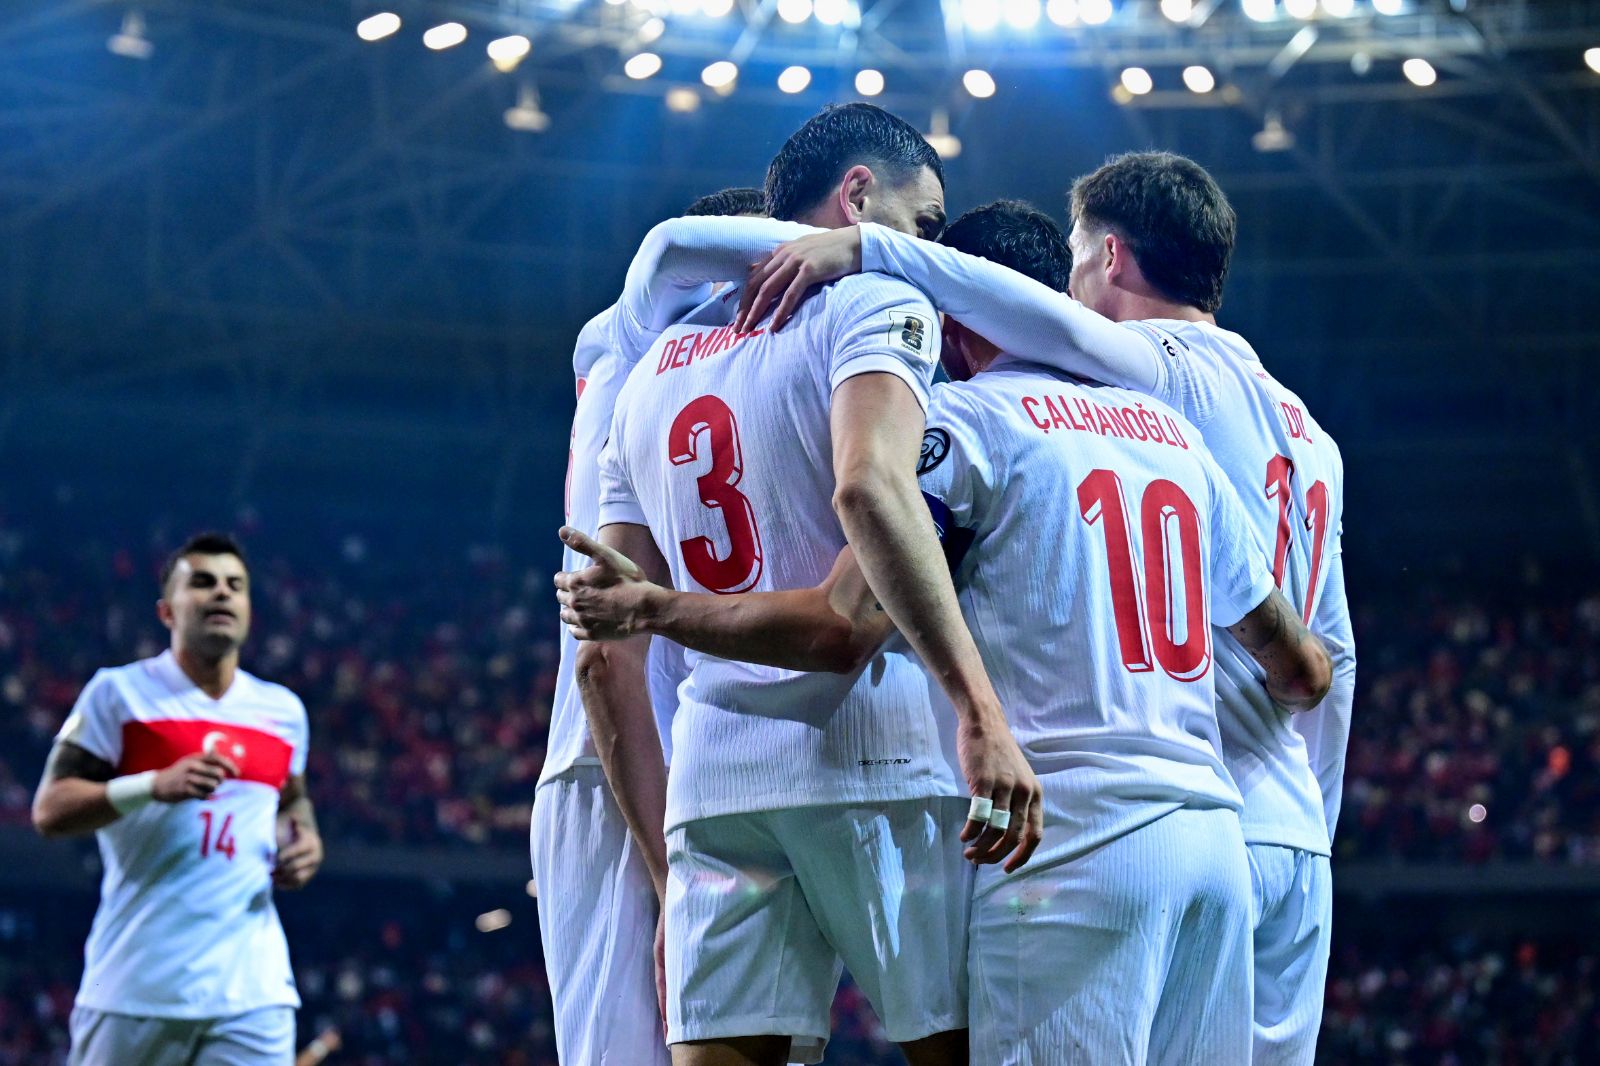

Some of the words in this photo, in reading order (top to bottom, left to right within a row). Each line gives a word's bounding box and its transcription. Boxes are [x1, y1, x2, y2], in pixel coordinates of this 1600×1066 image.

[668, 394, 764, 594] 3
[1020, 396, 1189, 451] ÇALHANOĞLU
[1077, 468, 1212, 683] 10
[1265, 453, 1330, 630] 11
[198, 810, 236, 861] 14
